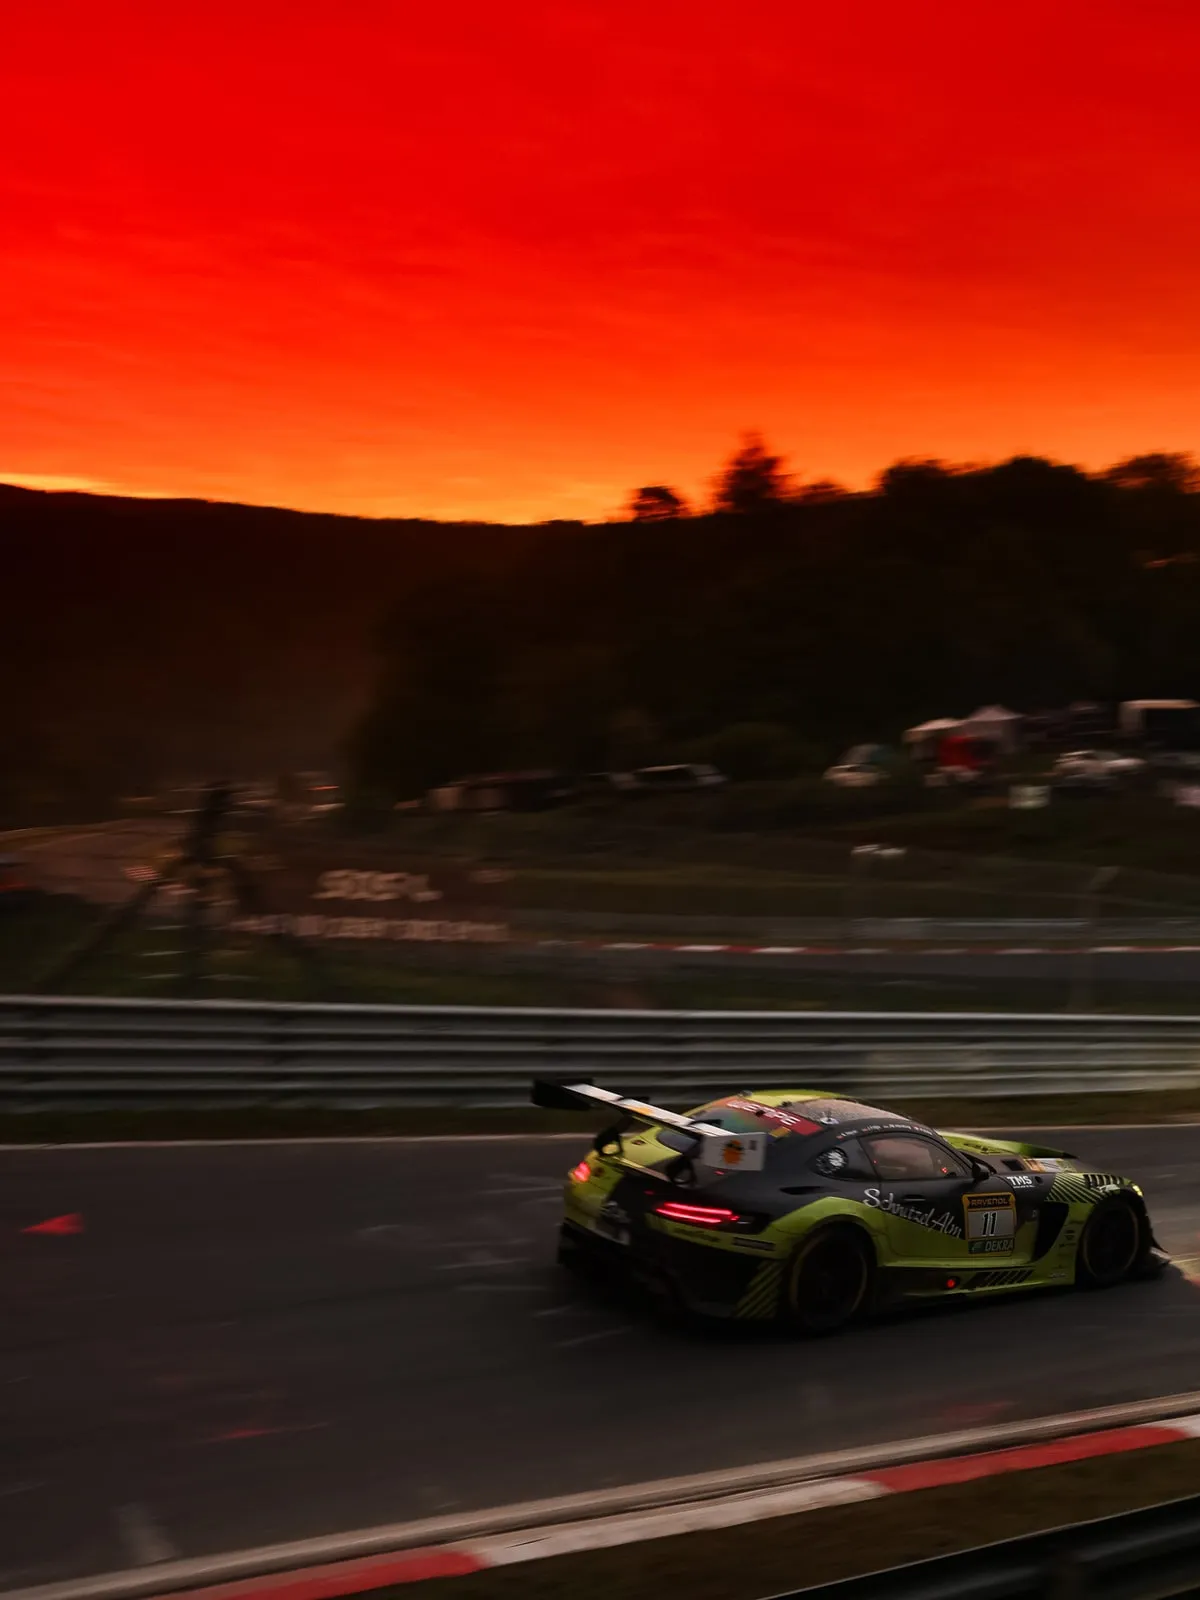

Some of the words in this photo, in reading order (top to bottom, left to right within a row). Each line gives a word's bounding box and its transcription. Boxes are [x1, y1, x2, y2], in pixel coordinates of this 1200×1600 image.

[1007, 1175, 1033, 1186] TMS
[982, 1210, 998, 1237] 11
[985, 1240, 1014, 1253] DEKRA
